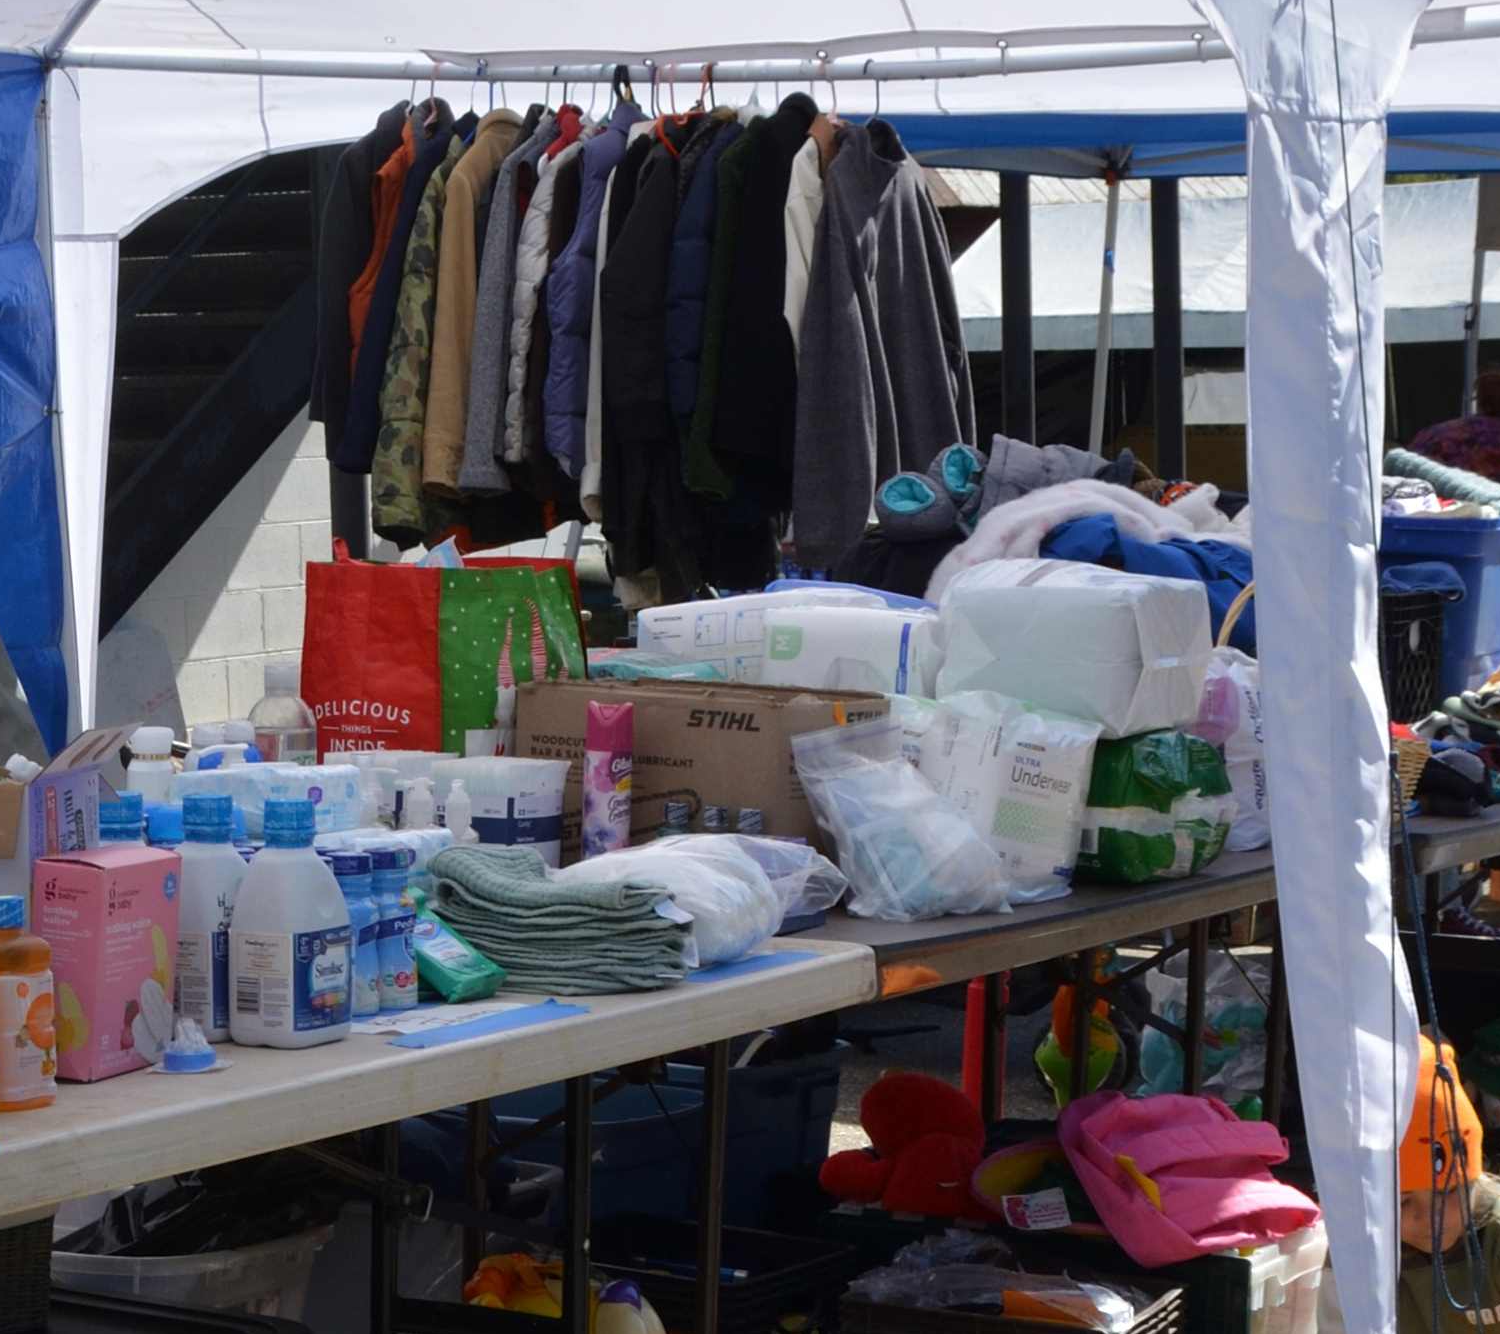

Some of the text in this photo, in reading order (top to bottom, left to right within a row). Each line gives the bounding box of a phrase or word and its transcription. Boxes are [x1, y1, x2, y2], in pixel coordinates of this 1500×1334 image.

[315, 700, 411, 725] DELICIOUS
[686, 708, 762, 734] STIHL
[340, 724, 373, 735] THINGS
[330, 739, 387, 753] INSIDE
[634, 756, 695, 769] LUBRICANT
[1011, 765, 1072, 795] Underwear
